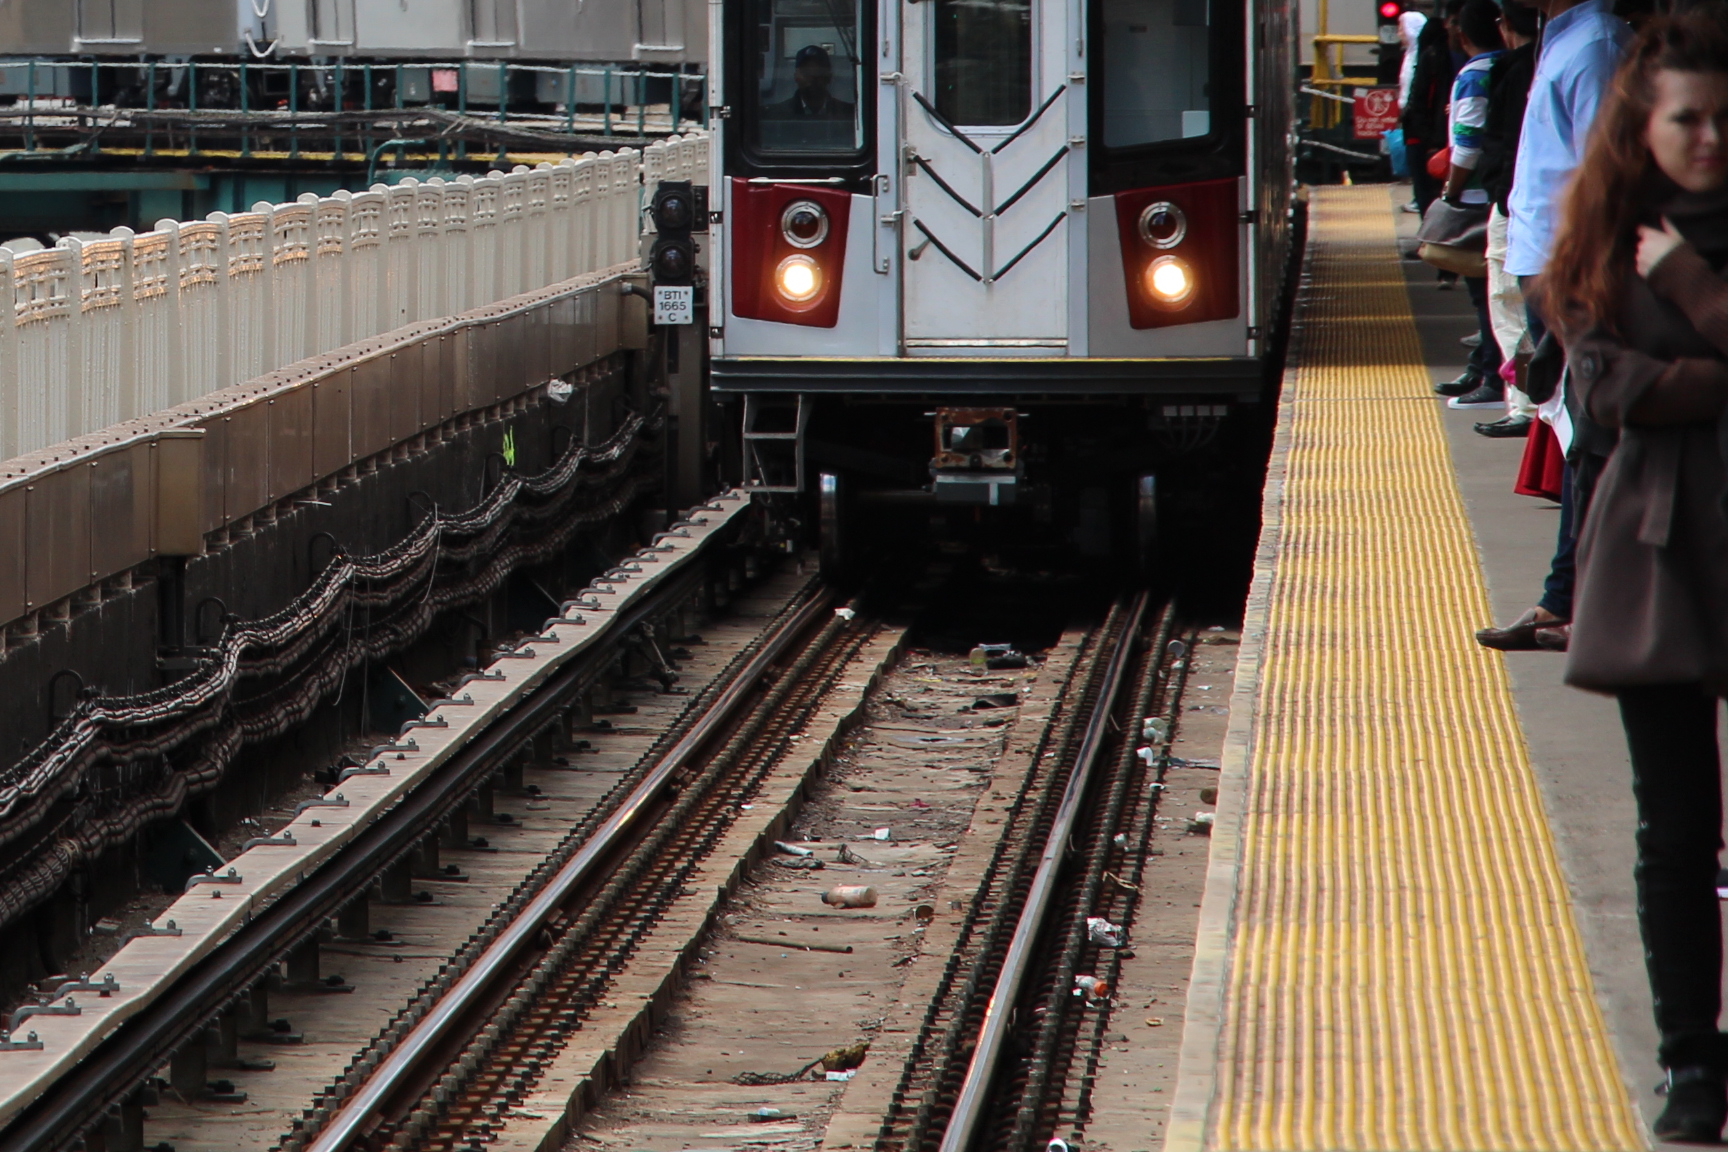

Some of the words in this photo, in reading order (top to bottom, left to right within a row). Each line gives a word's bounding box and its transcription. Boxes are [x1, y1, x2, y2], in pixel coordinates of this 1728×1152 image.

[663, 290, 682, 300] BTI
[659, 301, 687, 311] 1665
[668, 312, 677, 322] C
